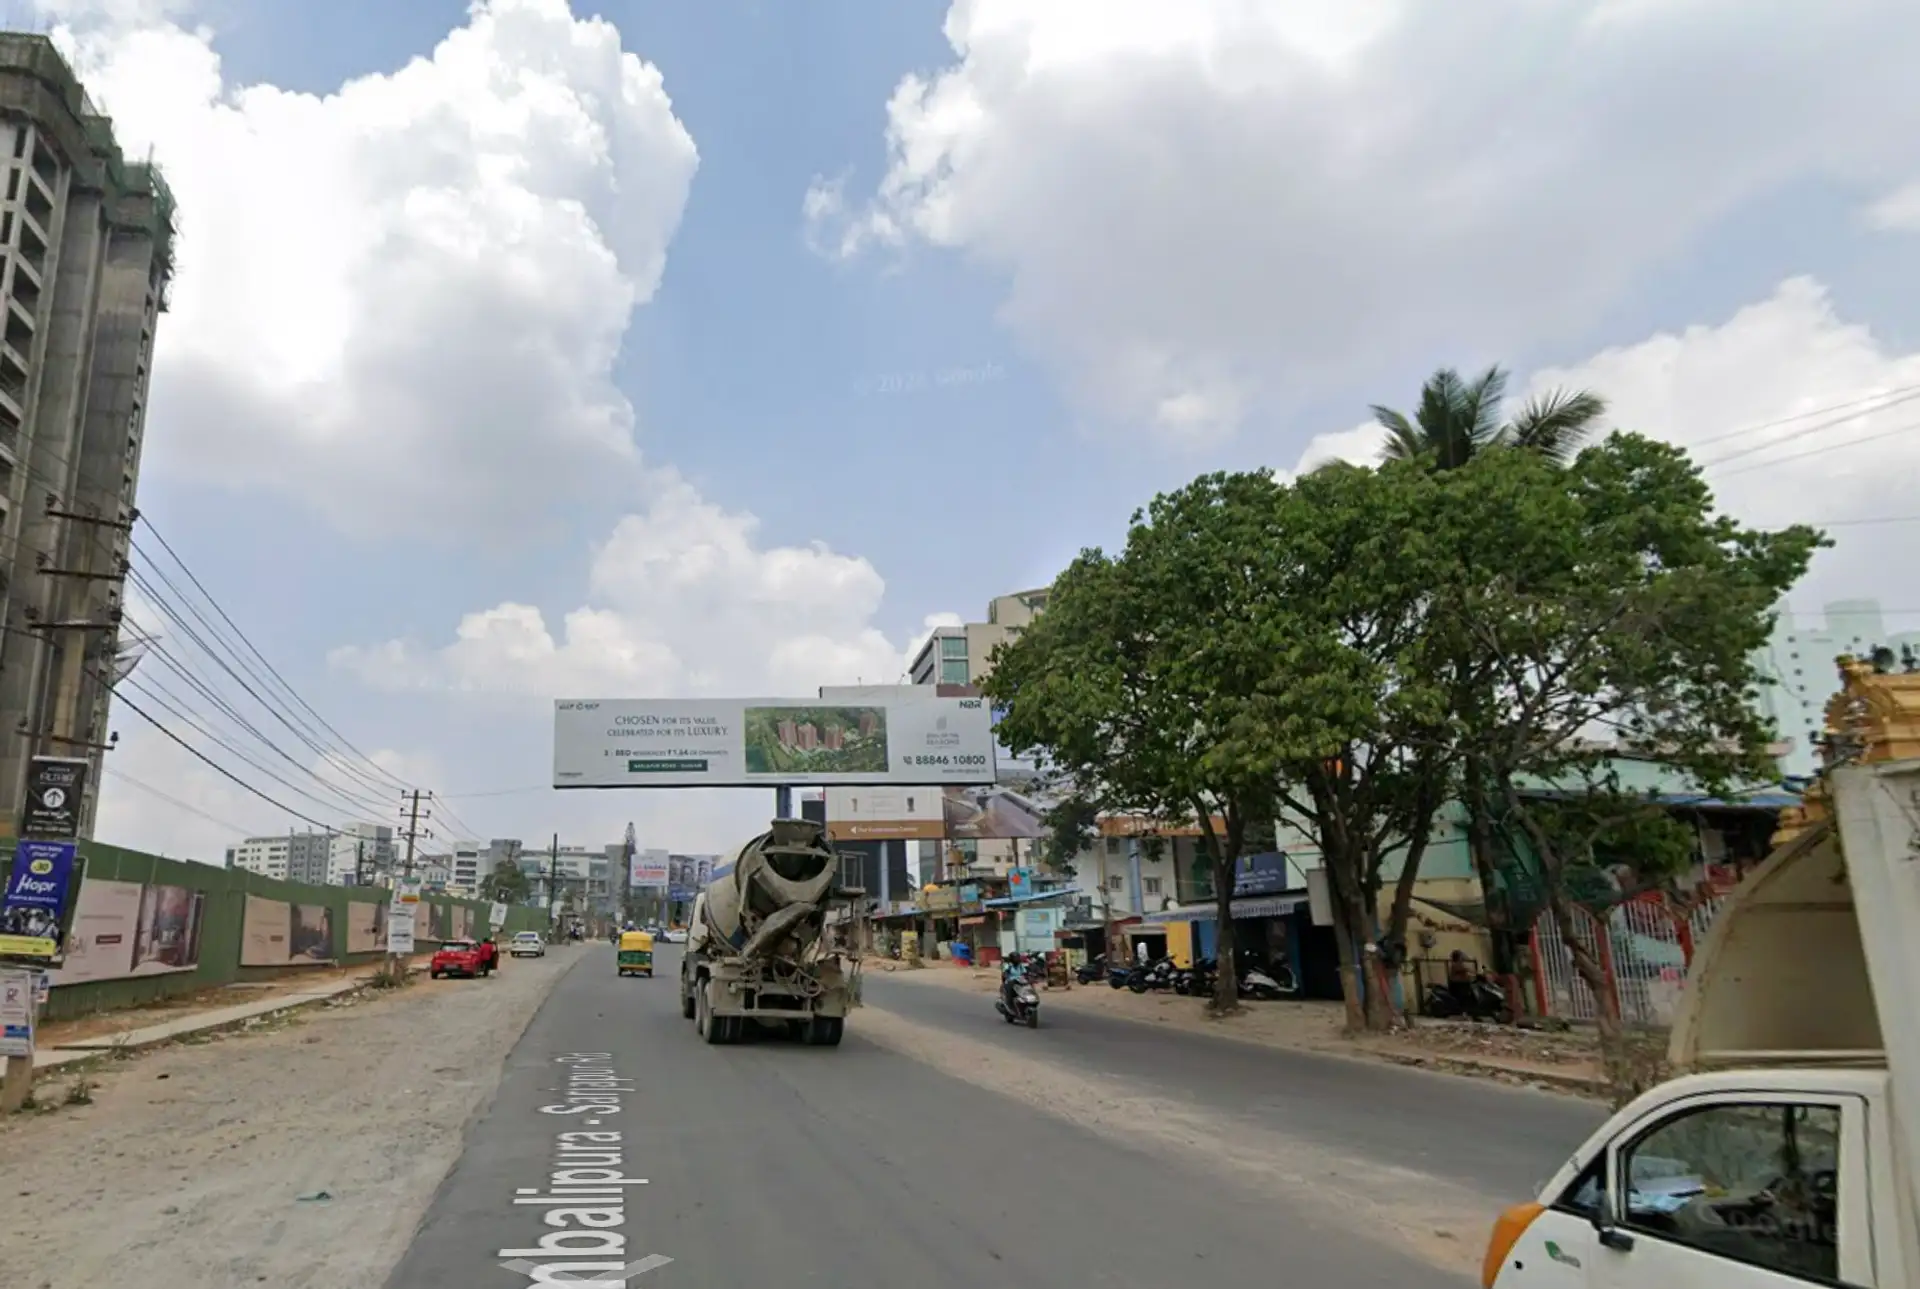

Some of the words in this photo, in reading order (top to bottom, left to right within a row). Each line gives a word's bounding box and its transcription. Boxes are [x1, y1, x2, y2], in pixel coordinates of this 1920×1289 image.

[615, 715, 660, 725] CHOSEN
[607, 728, 653, 737] CELEBRATED
[656, 728, 671, 736] FOR
[916, 755, 949, 765] 88846
[952, 755, 985, 765] 10800
